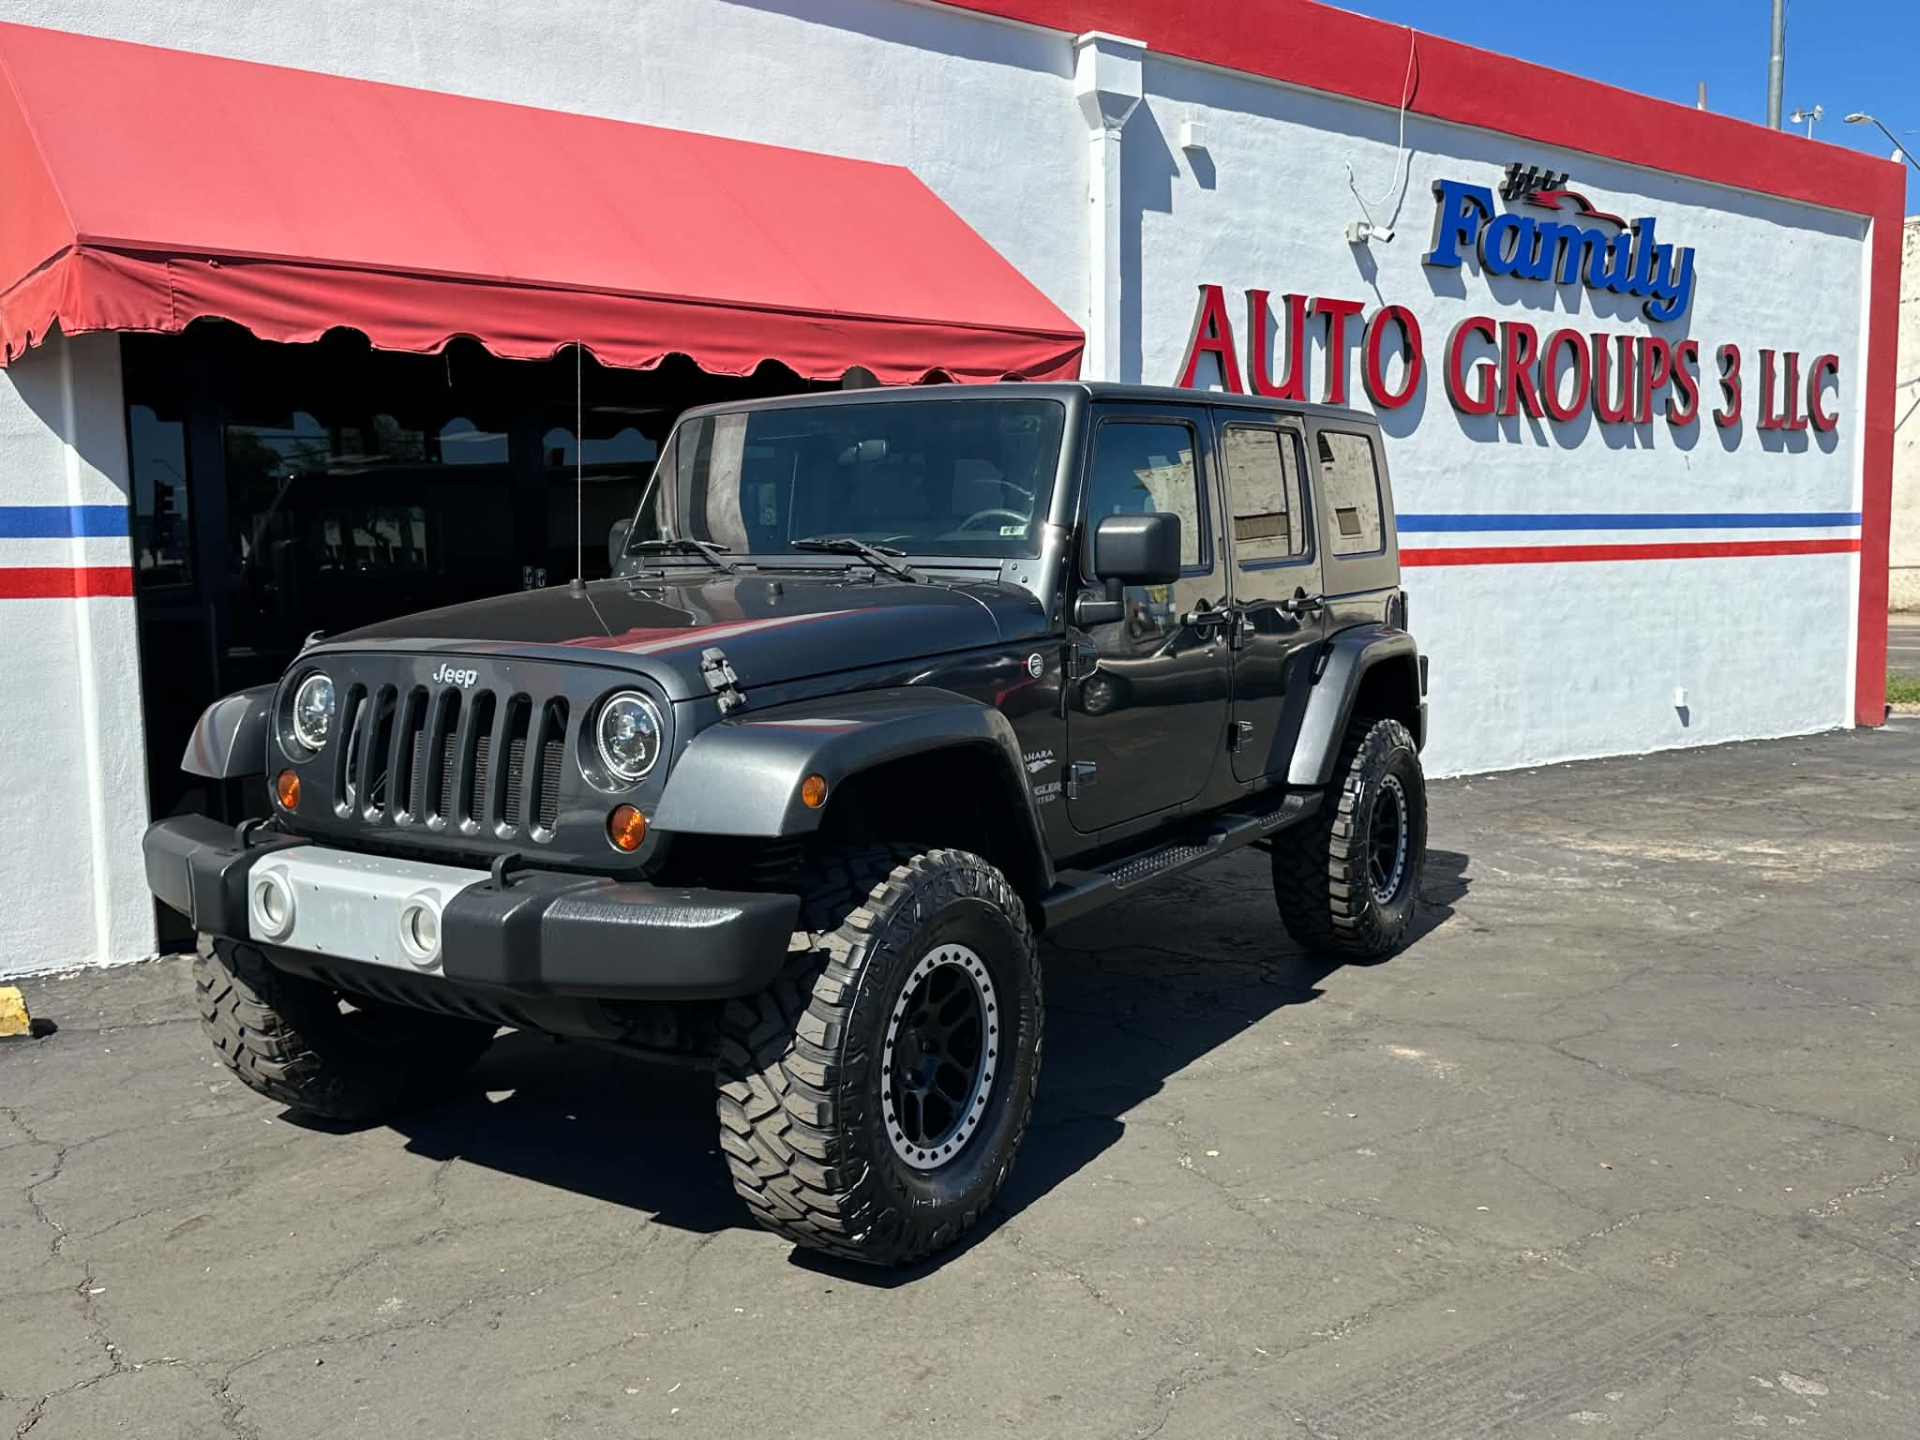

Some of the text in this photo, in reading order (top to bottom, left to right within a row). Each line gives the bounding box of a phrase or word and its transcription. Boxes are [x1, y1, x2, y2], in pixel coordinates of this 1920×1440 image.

[1421, 178, 1695, 322] Family
[1173, 284, 1839, 433] AUTO GROUPS 3 LLC
[432, 663, 477, 689] Jeep
